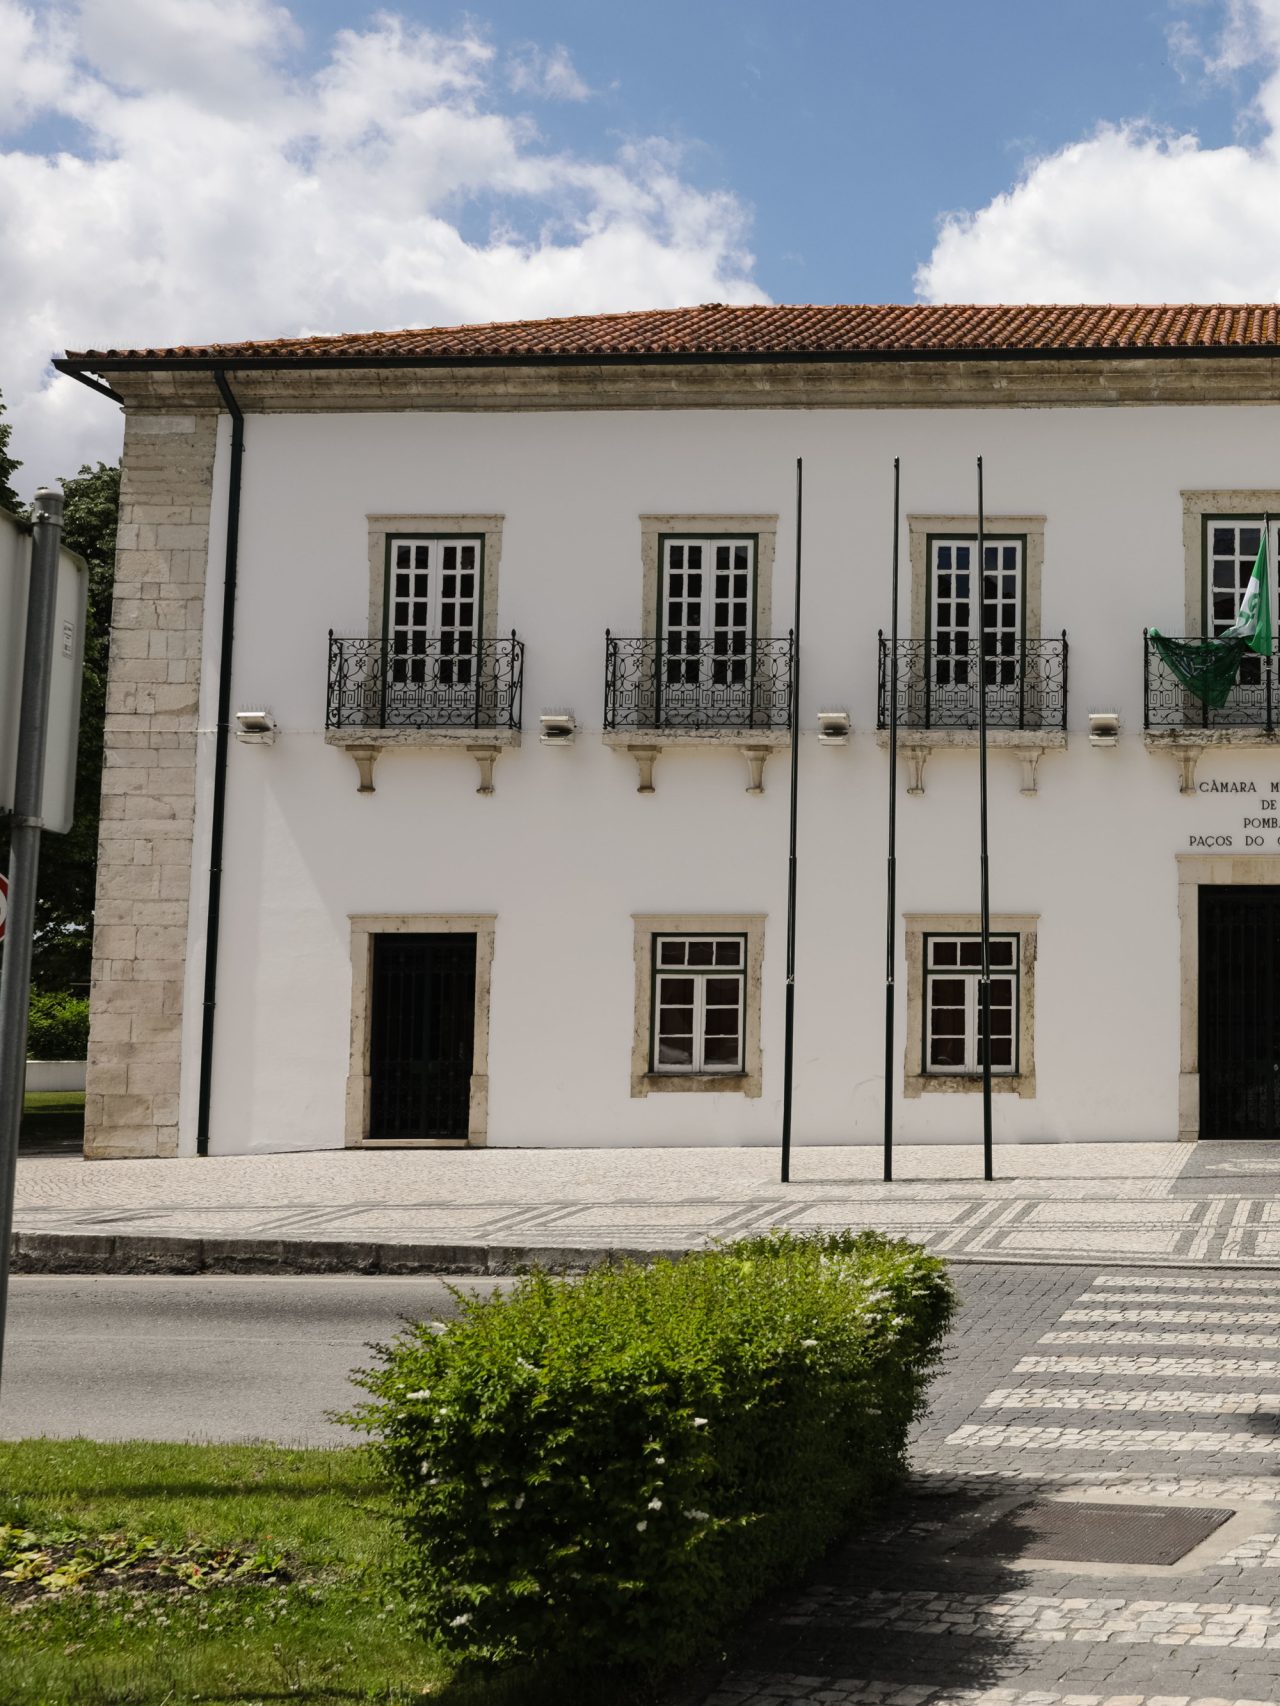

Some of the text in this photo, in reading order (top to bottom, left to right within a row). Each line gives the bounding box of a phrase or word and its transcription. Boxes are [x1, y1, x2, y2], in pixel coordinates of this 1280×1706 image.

[1199, 780, 1256, 793] CÂMARA
[1261, 800, 1277, 810] DE
[1189, 835, 1232, 847] PAÇOS
[1245, 835, 1264, 846] DO
